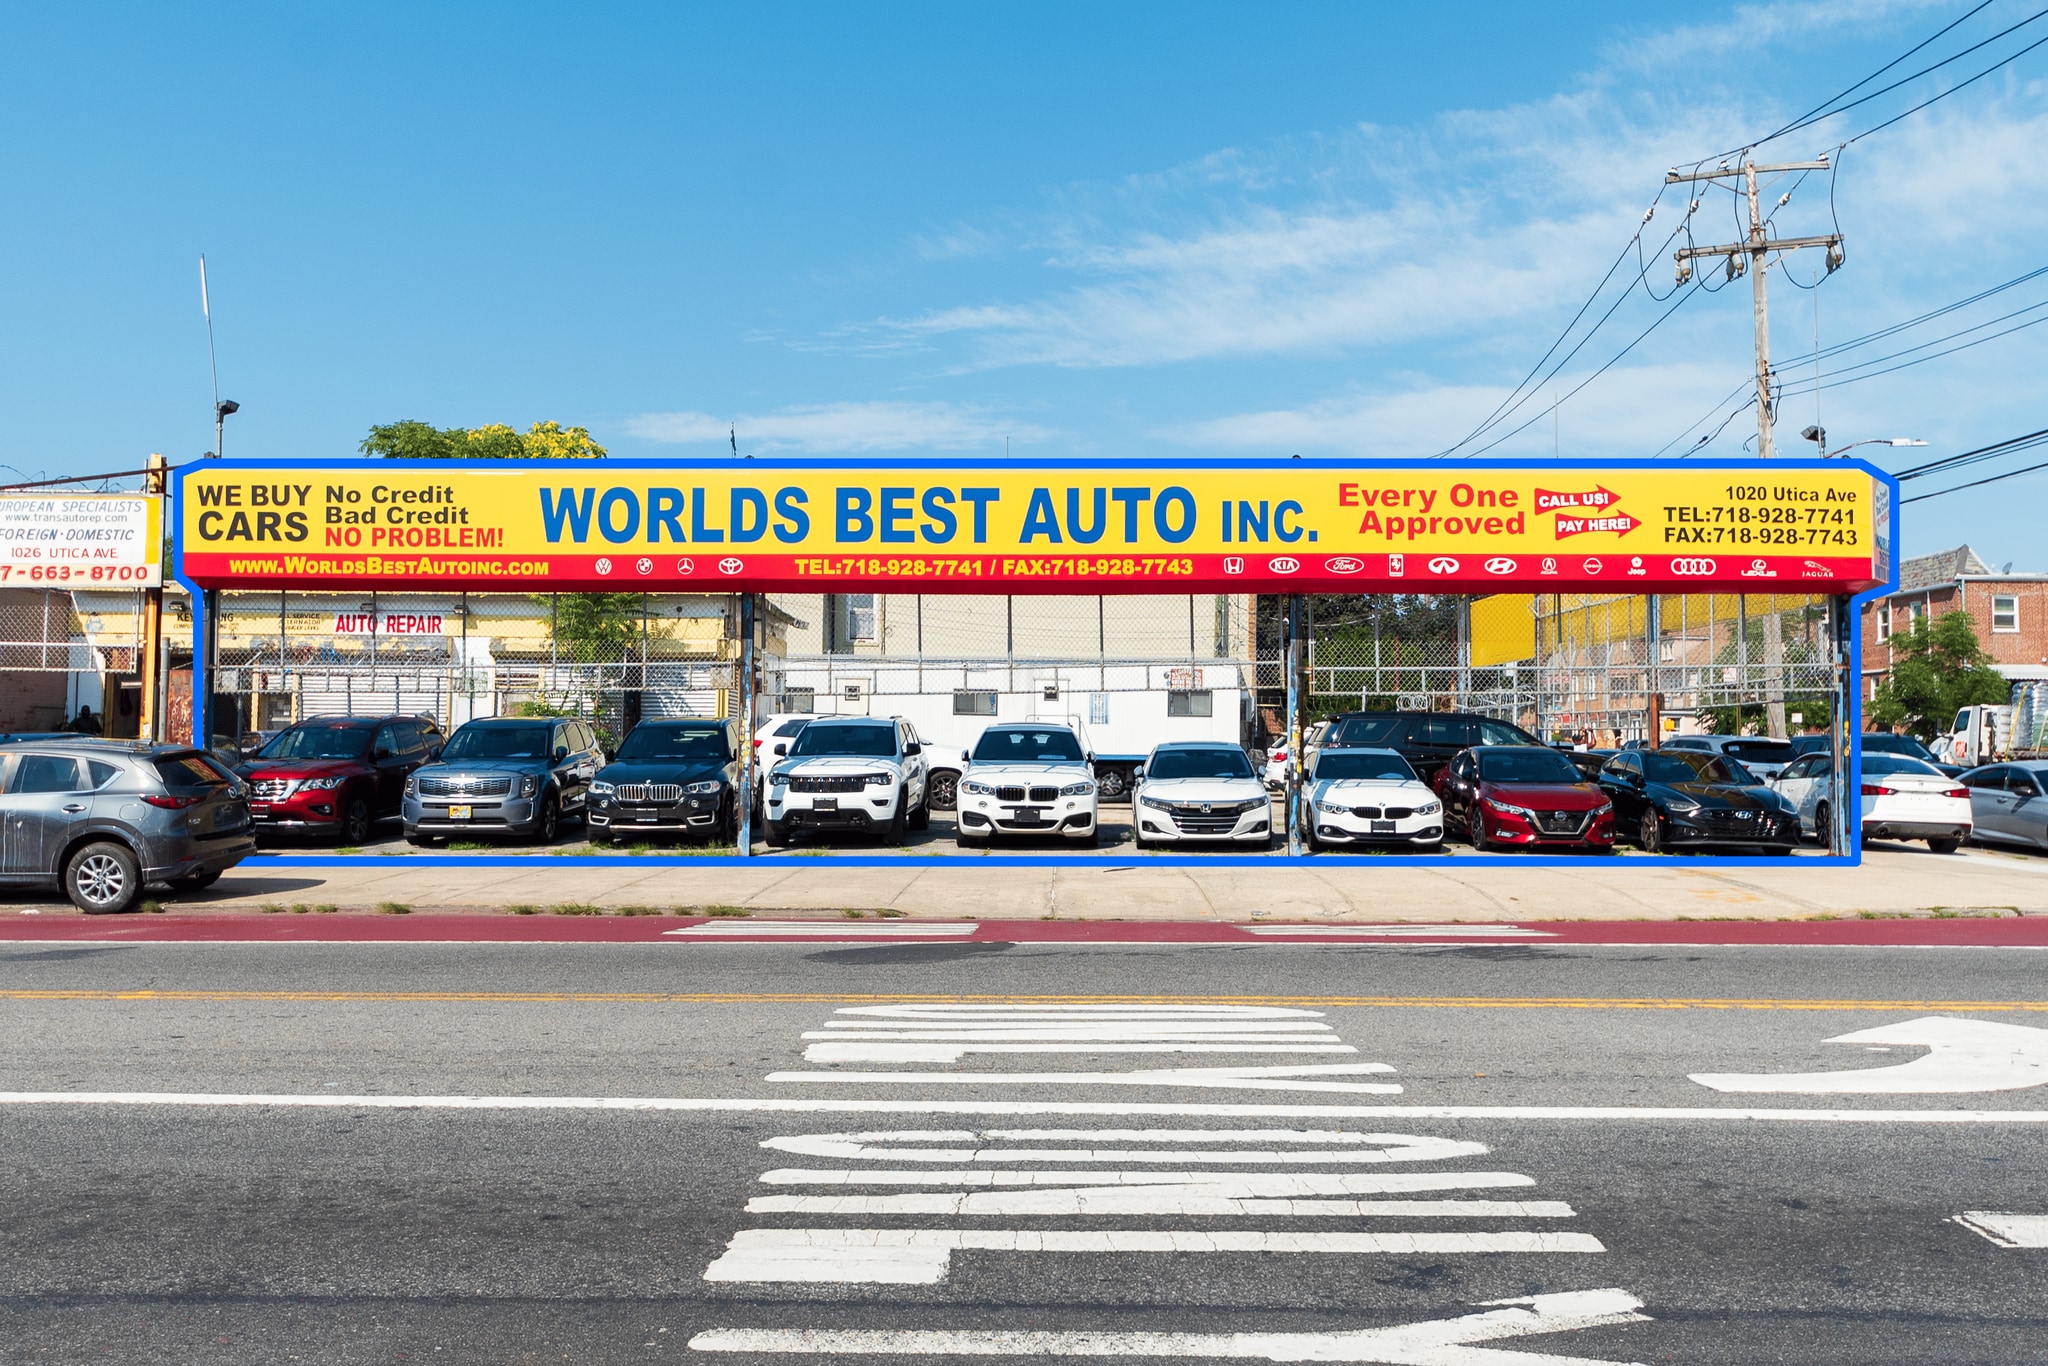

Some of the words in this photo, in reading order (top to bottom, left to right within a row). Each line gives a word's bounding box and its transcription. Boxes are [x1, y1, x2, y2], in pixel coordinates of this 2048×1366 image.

[197, 485, 242, 506] WE
[251, 485, 312, 506] BUY
[326, 485, 361, 504] No
[371, 485, 454, 504] Credit
[1338, 482, 1438, 513] Every
[1450, 483, 1519, 508] One
[1538, 494, 1579, 507] CALL
[1582, 493, 1609, 505] US!
[1725, 486, 1767, 501] 1020
[1773, 487, 1819, 502] Utica
[1825, 487, 1857, 502] Ave
[62, 501, 142, 513] SPECIALISTS
[325, 506, 376, 524] Bad
[386, 506, 469, 525] Credit
[538, 486, 811, 544] WORLDS
[835, 486, 1001, 544] BEST
[1018, 486, 1198, 544] AUTO
[1221, 499, 1319, 543] INC.
[1663, 506, 1855, 525] TEL:718-928-7741
[5, 513, 128, 523] www.transautorep.com
[198, 510, 309, 542] CARS
[1358, 510, 1526, 541] Approved
[1557, 520, 1585, 532] PAY
[1588, 518, 1631, 531] HERE!
[325, 527, 362, 547] NO
[371, 527, 503, 547] PROBLEM!
[1664, 527, 1858, 546] FAX:718-928-7743
[11, 547, 42, 558] 1026
[49, 548, 90, 559] UTICA
[794, 559, 982, 576] TEL:718-928-7741
[1002, 559, 1193, 576] FAX:718-928-7743
[1273, 560, 1295, 570] KIA
[1332, 560, 1356, 571] Ford
[1627, 568, 1647, 576] Jeep
[1802, 570, 1834, 578] JAGUAR
[335, 614, 378, 633] AUTO
[386, 614, 442, 633] REPAIR
